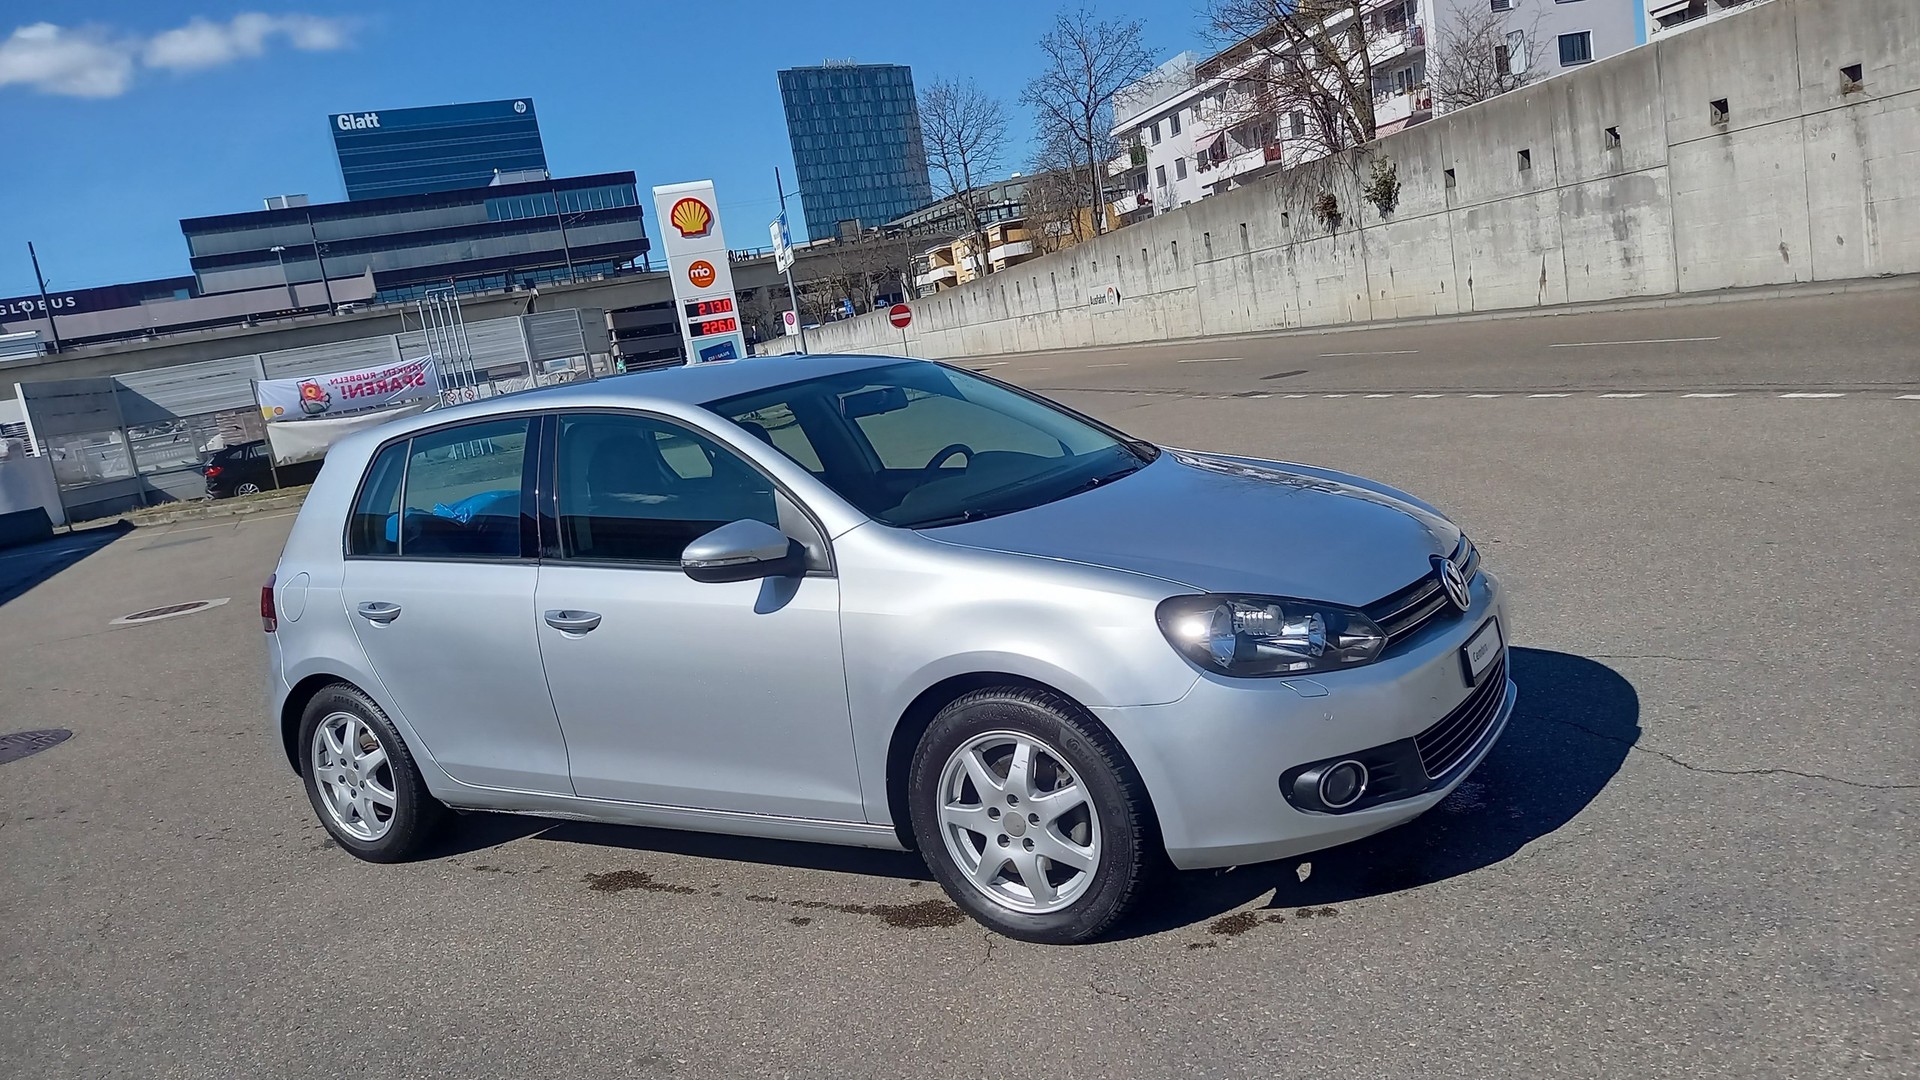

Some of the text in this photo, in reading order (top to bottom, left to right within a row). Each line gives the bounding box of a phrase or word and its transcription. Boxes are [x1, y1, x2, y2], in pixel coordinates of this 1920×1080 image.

[514, 101, 526, 113] hp
[337, 113, 380, 130] Glatt
[690, 265, 710, 278] mio
[0, 297, 76, 316] GLOBUS
[698, 299, 732, 315] 213.0
[702, 319, 735, 335] 226.0
